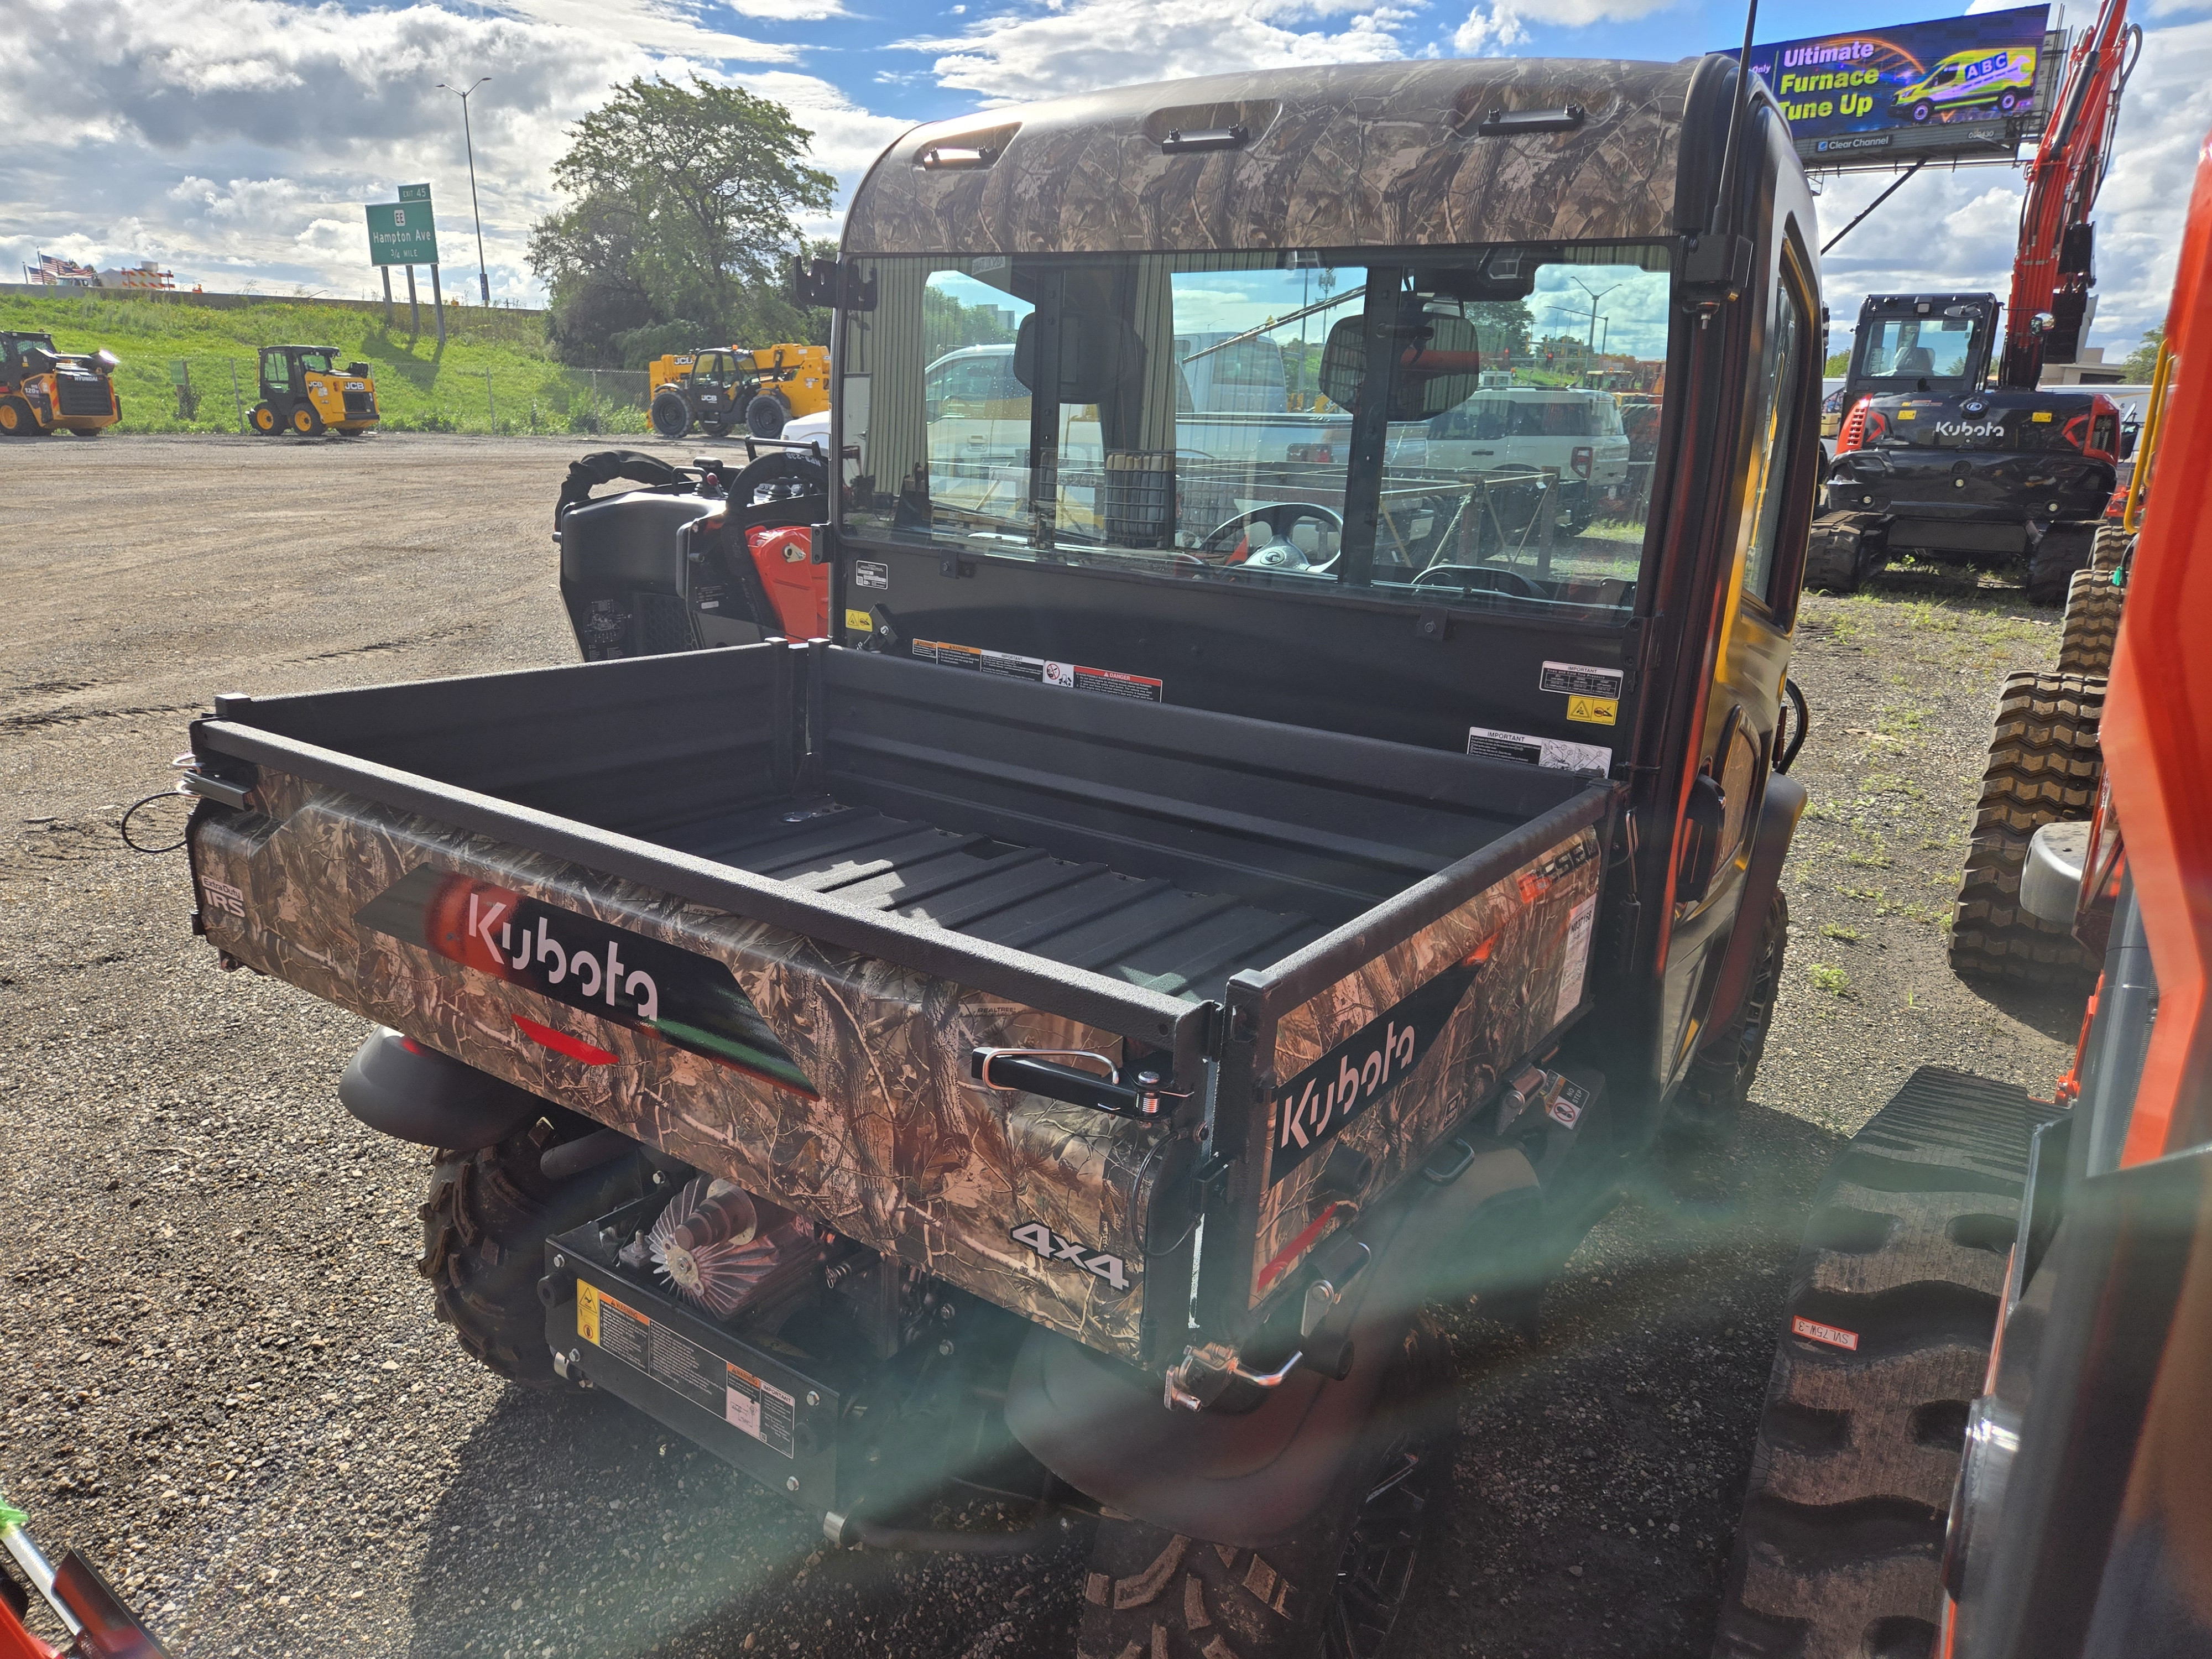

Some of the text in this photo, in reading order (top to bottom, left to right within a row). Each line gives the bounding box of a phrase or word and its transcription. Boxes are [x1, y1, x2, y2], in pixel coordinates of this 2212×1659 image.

[1783, 41, 1874, 67] Ultimate
[1752, 64, 1771, 74] Only
[1966, 54, 2007, 80] ABC
[1780, 69, 1880, 95] Furnace
[1778, 93, 1873, 121] Tune Up
[1829, 136, 1889, 150] Clear Channel
[416, 188, 426, 197] 45
[395, 213, 404, 223] EE
[373, 229, 431, 244] Hampton Ave
[390, 249, 418, 259] 3/4 MILE
[345, 382, 365, 390] JCB
[1935, 421, 2005, 436] Kubota
[1488, 732, 1525, 742] IMPORTANT
[205, 889, 245, 917] IRS
[468, 892, 658, 1022] Kubota
[1281, 1021, 1416, 1151] Kubota
[1566, 1088, 1575, 1097] NO
[1572, 1089, 1583, 1104] STEP
[1444, 1108, 1457, 1124] STEP
[1012, 1223, 1129, 1291] 4x4
[616, 1302, 638, 1319] WARNING
[1798, 1321, 1849, 1344] SVL75W-3
[736, 1368, 758, 1385] WARNING
[763, 1384, 791, 1403] IMPORTANT
